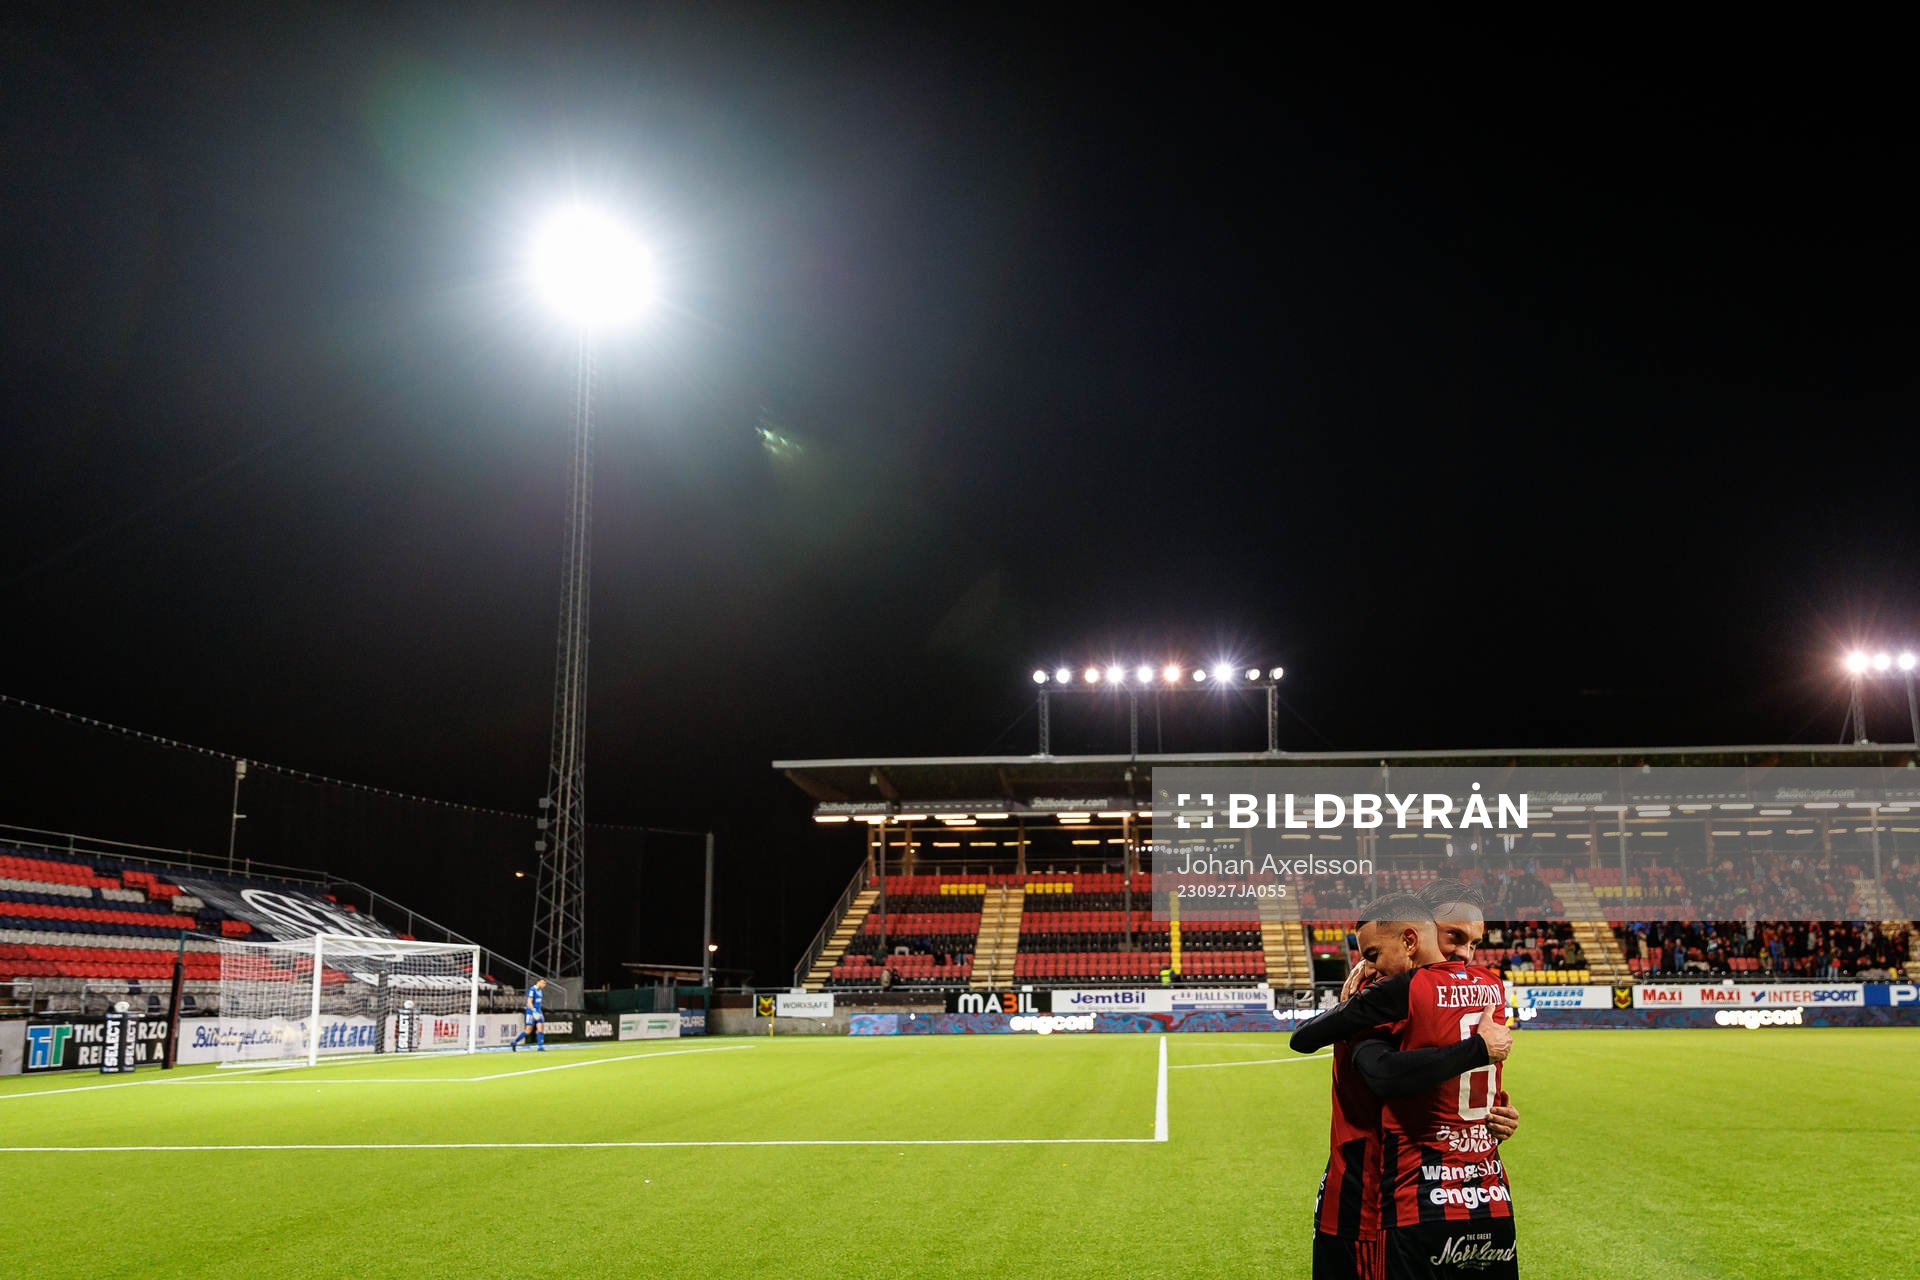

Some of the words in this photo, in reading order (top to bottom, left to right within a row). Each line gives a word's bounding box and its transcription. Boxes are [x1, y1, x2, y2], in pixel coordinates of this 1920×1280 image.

[1071, 992, 1145, 1004] JemtBil
[1768, 990, 1858, 1003] INTERSPORT
[1010, 1014, 1096, 1035] engcon
[1715, 1007, 1803, 1029] engcon
[104, 1020, 121, 1067] SELECT
[1429, 1184, 1511, 1210] engcon
